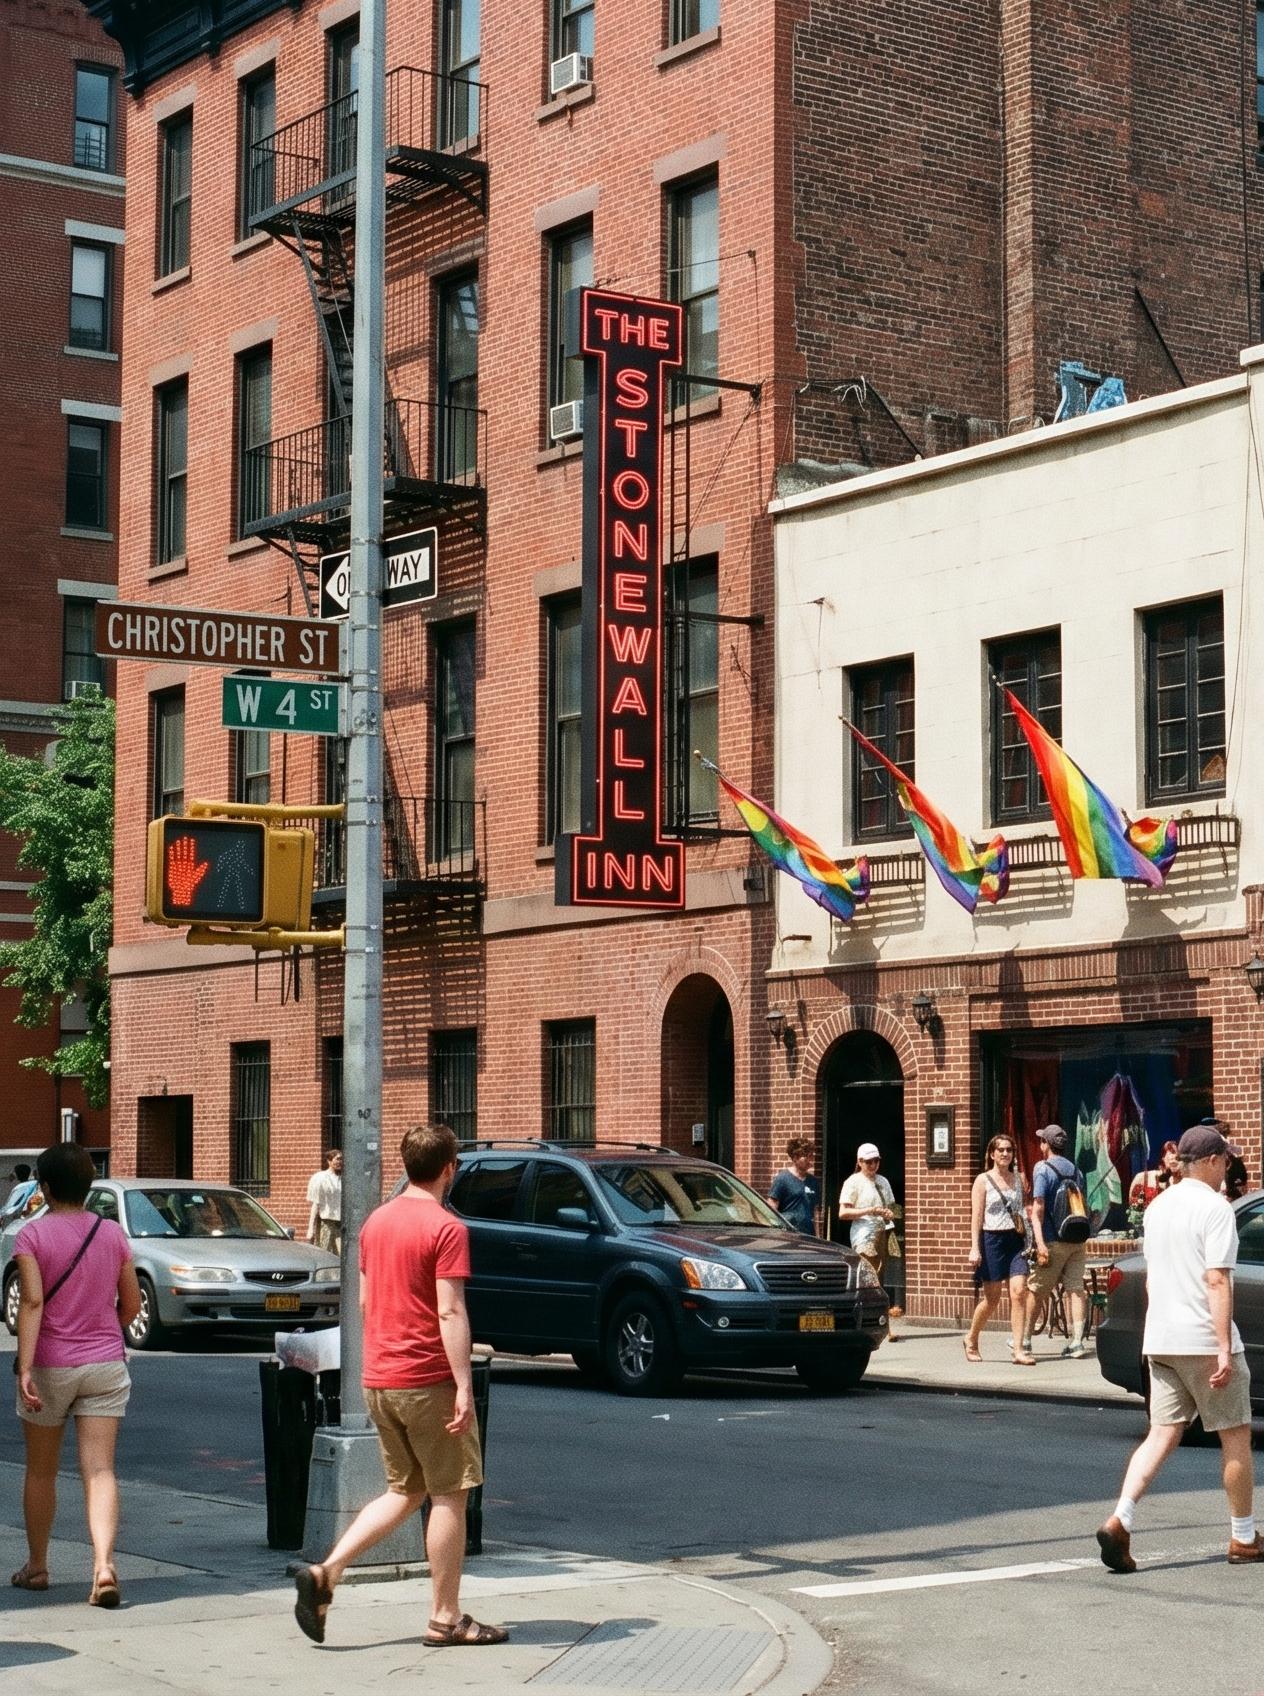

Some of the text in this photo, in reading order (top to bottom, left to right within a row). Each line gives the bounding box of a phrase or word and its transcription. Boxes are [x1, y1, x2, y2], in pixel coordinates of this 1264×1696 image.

[594, 308, 670, 350] THE
[386, 552, 422, 587] WAY
[608, 368, 651, 820] STONEWALL
[107, 611, 329, 665] CHRISTOPHER ST
[235, 683, 333, 725] W 4 ST
[587, 852, 673, 892] INN
